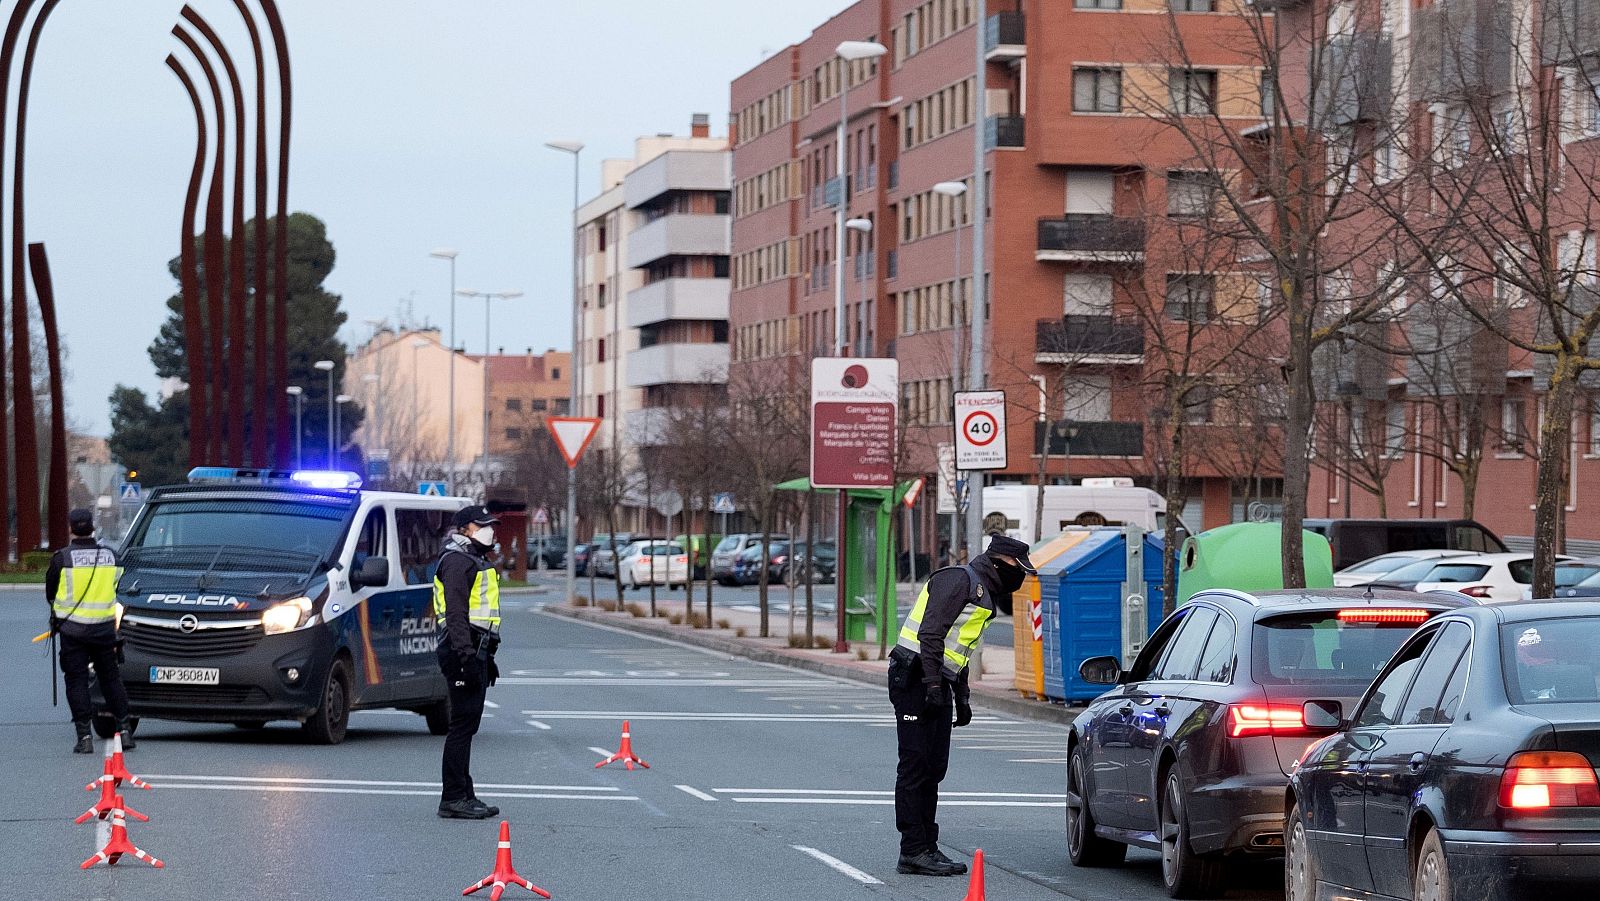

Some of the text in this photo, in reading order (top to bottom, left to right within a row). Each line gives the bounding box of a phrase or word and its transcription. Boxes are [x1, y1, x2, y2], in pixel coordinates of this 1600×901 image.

[970, 422, 991, 434] 40
[400, 636, 438, 655] NACIONA
[1291, 759, 1300, 767] A
